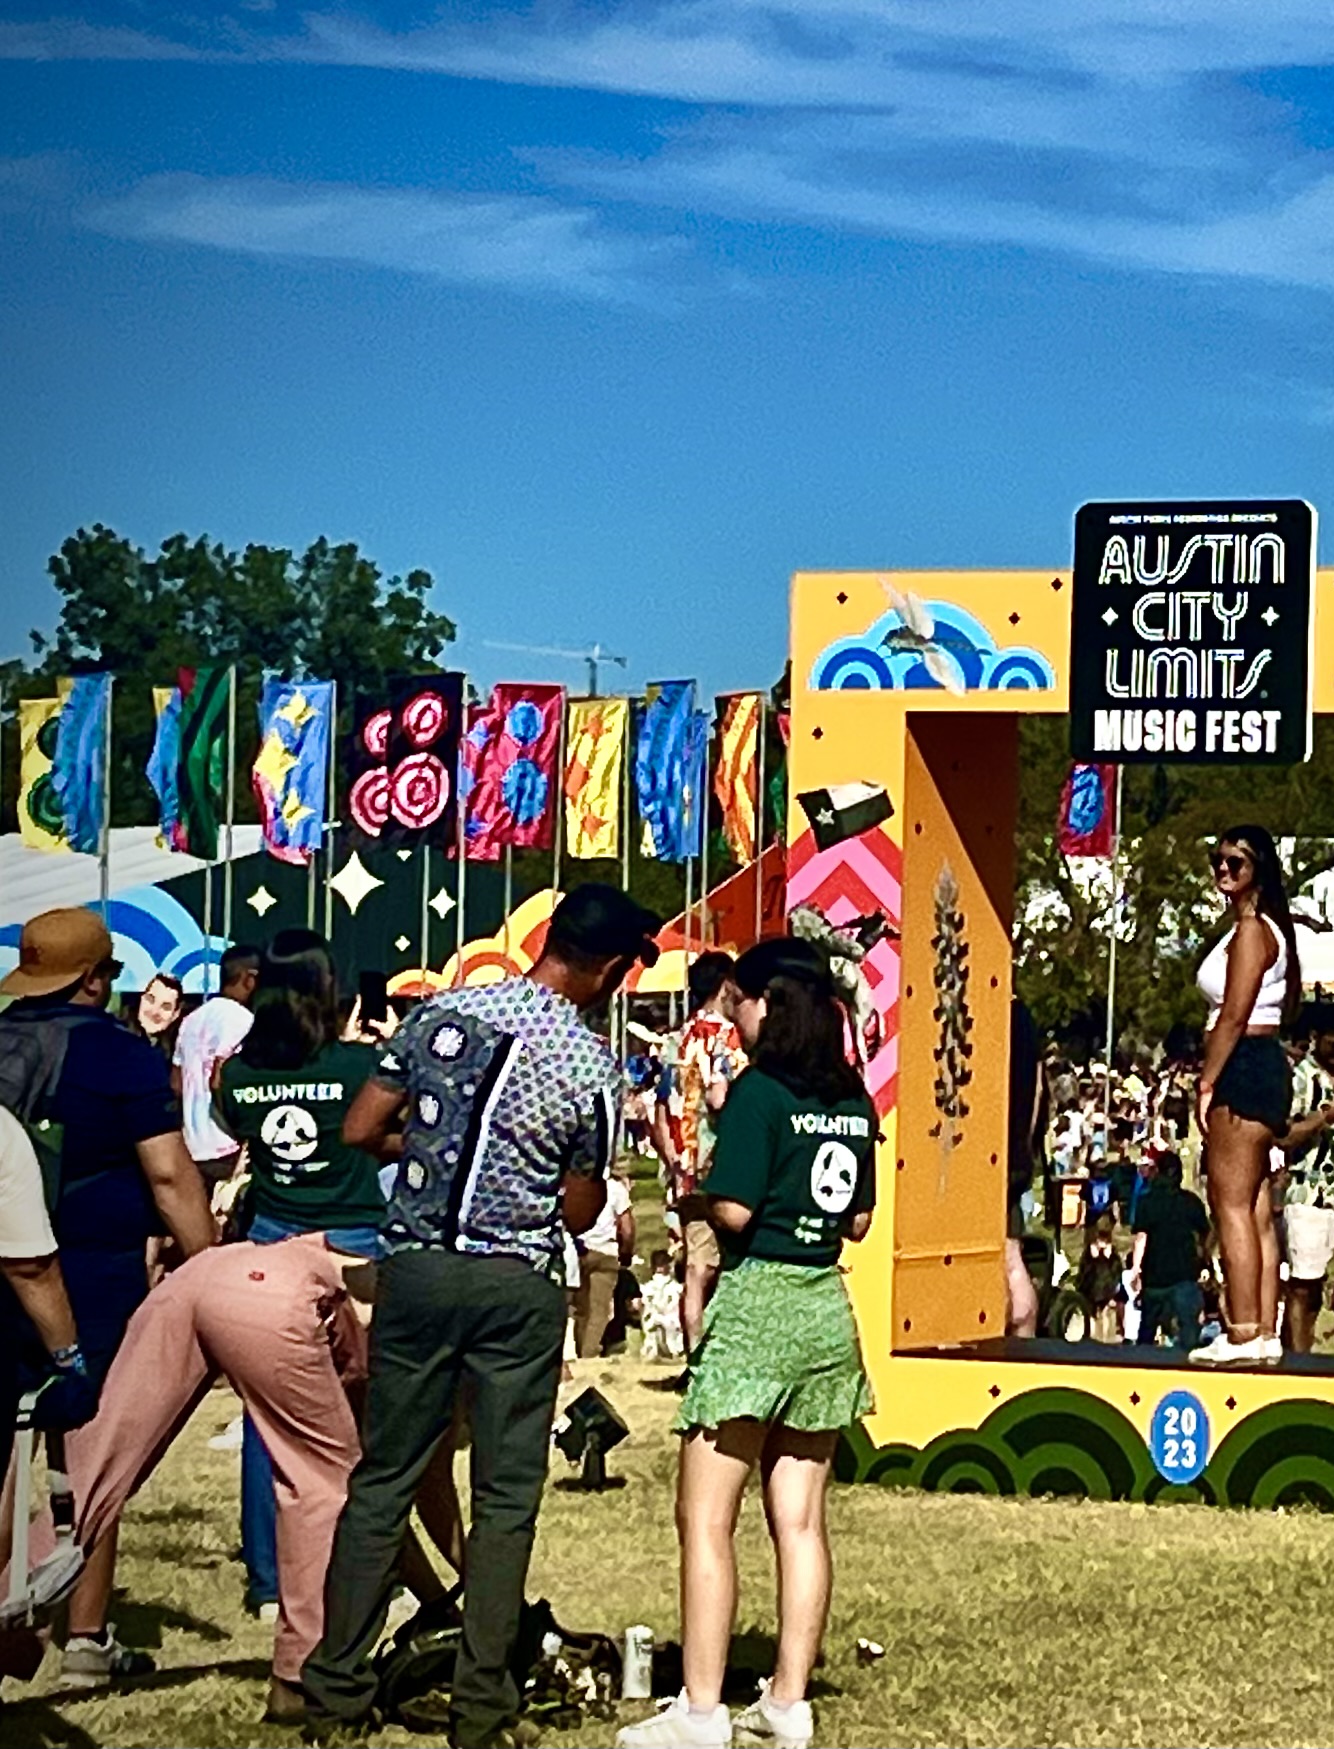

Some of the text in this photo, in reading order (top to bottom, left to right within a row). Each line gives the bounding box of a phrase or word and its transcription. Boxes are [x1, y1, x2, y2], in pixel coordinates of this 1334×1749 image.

[1098, 532, 1285, 586] AUSTIN
[1132, 591, 1249, 642] CITY
[1105, 647, 1272, 699] LIMITS
[1093, 709, 1282, 753] MUSIC FEST
[232, 1082, 344, 1104] VOLUNTEER
[1163, 1406, 1197, 1436] 20
[1163, 1438, 1197, 1469] 23
